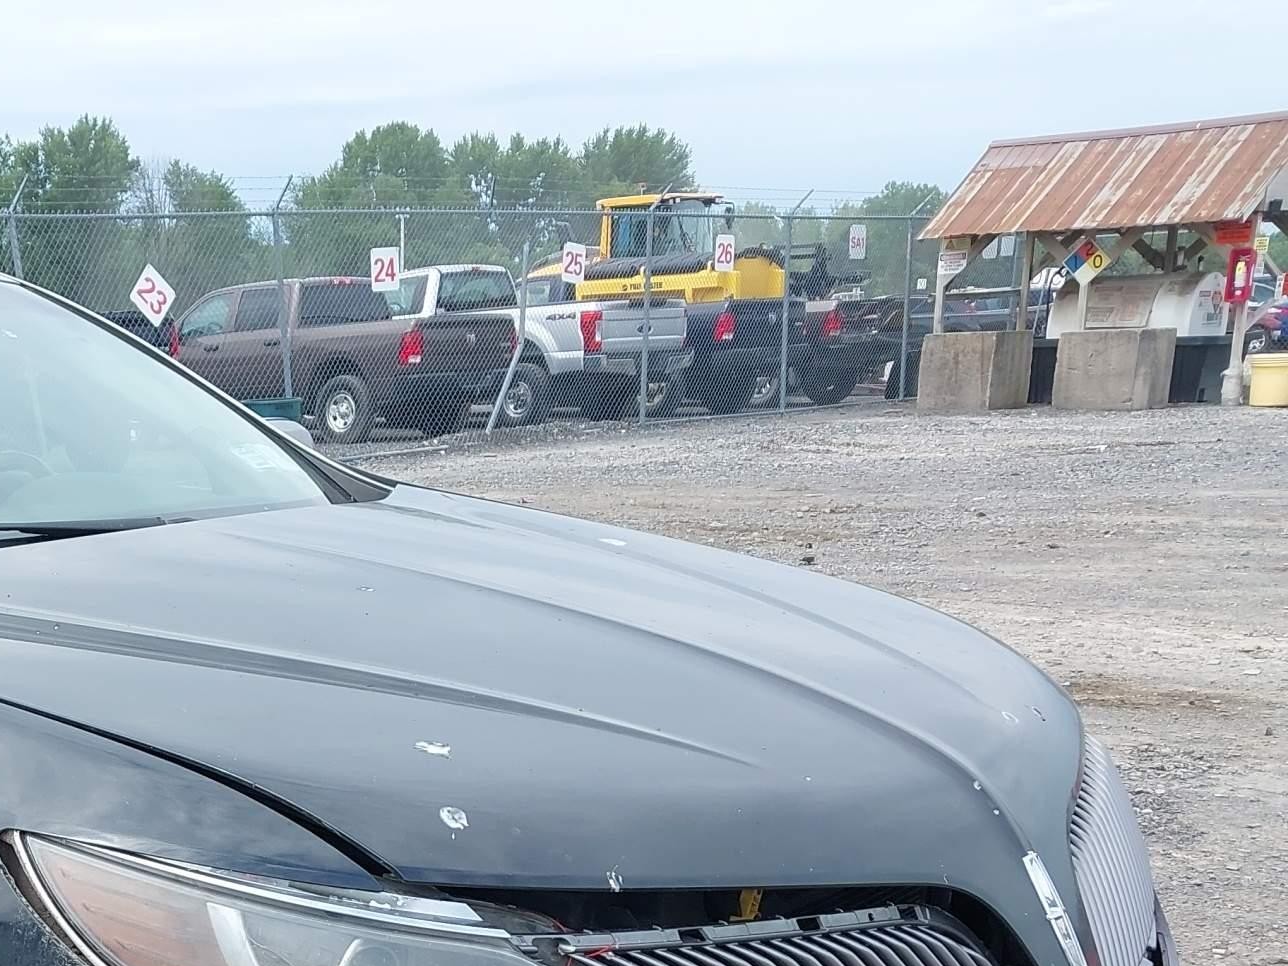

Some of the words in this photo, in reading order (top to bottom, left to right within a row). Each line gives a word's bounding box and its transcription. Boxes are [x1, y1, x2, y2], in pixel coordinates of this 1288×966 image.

[716, 242, 733, 264] 26
[1086, 242, 1096, 256] 2
[374, 257, 397, 283] 24
[564, 251, 584, 276] 25
[1092, 254, 1103, 269] 0
[136, 276, 168, 315] 23
